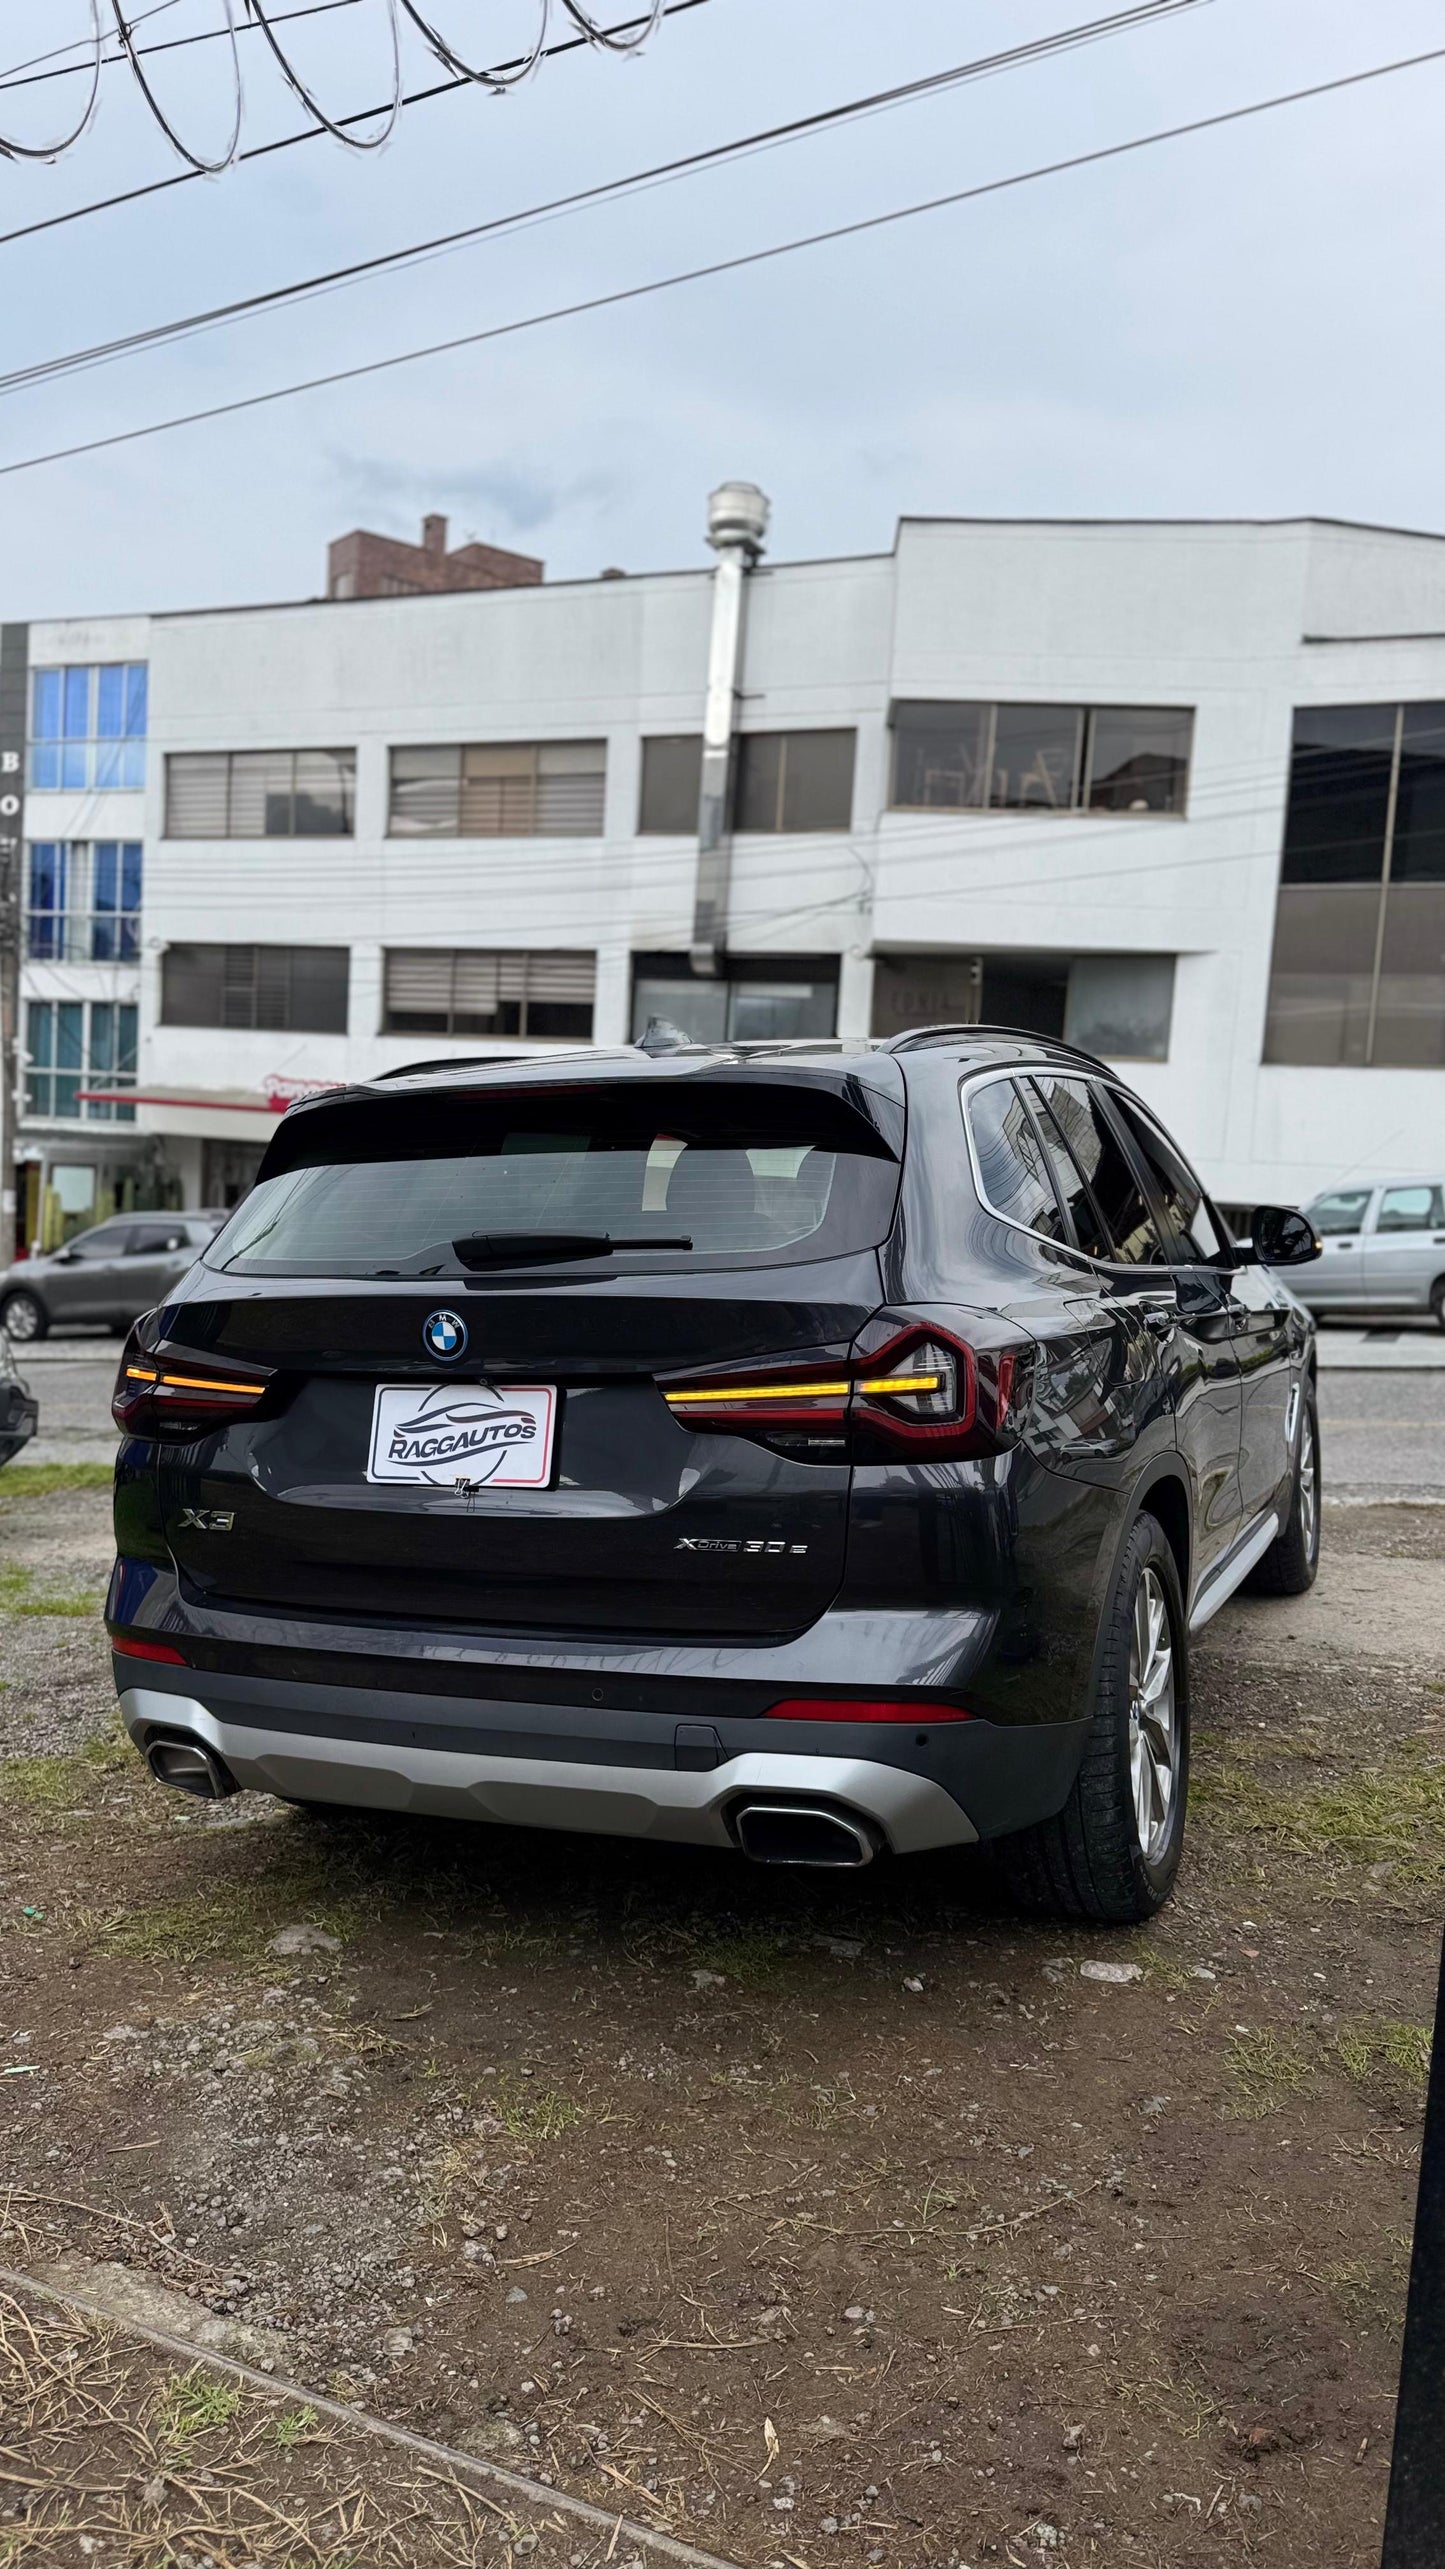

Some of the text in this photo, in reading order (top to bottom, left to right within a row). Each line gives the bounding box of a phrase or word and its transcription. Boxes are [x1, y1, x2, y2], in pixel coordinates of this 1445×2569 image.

[428, 1314, 461, 1329] BMW
[388, 1423, 537, 1460] RAGGAUTOS
[177, 1508, 235, 1531] X3
